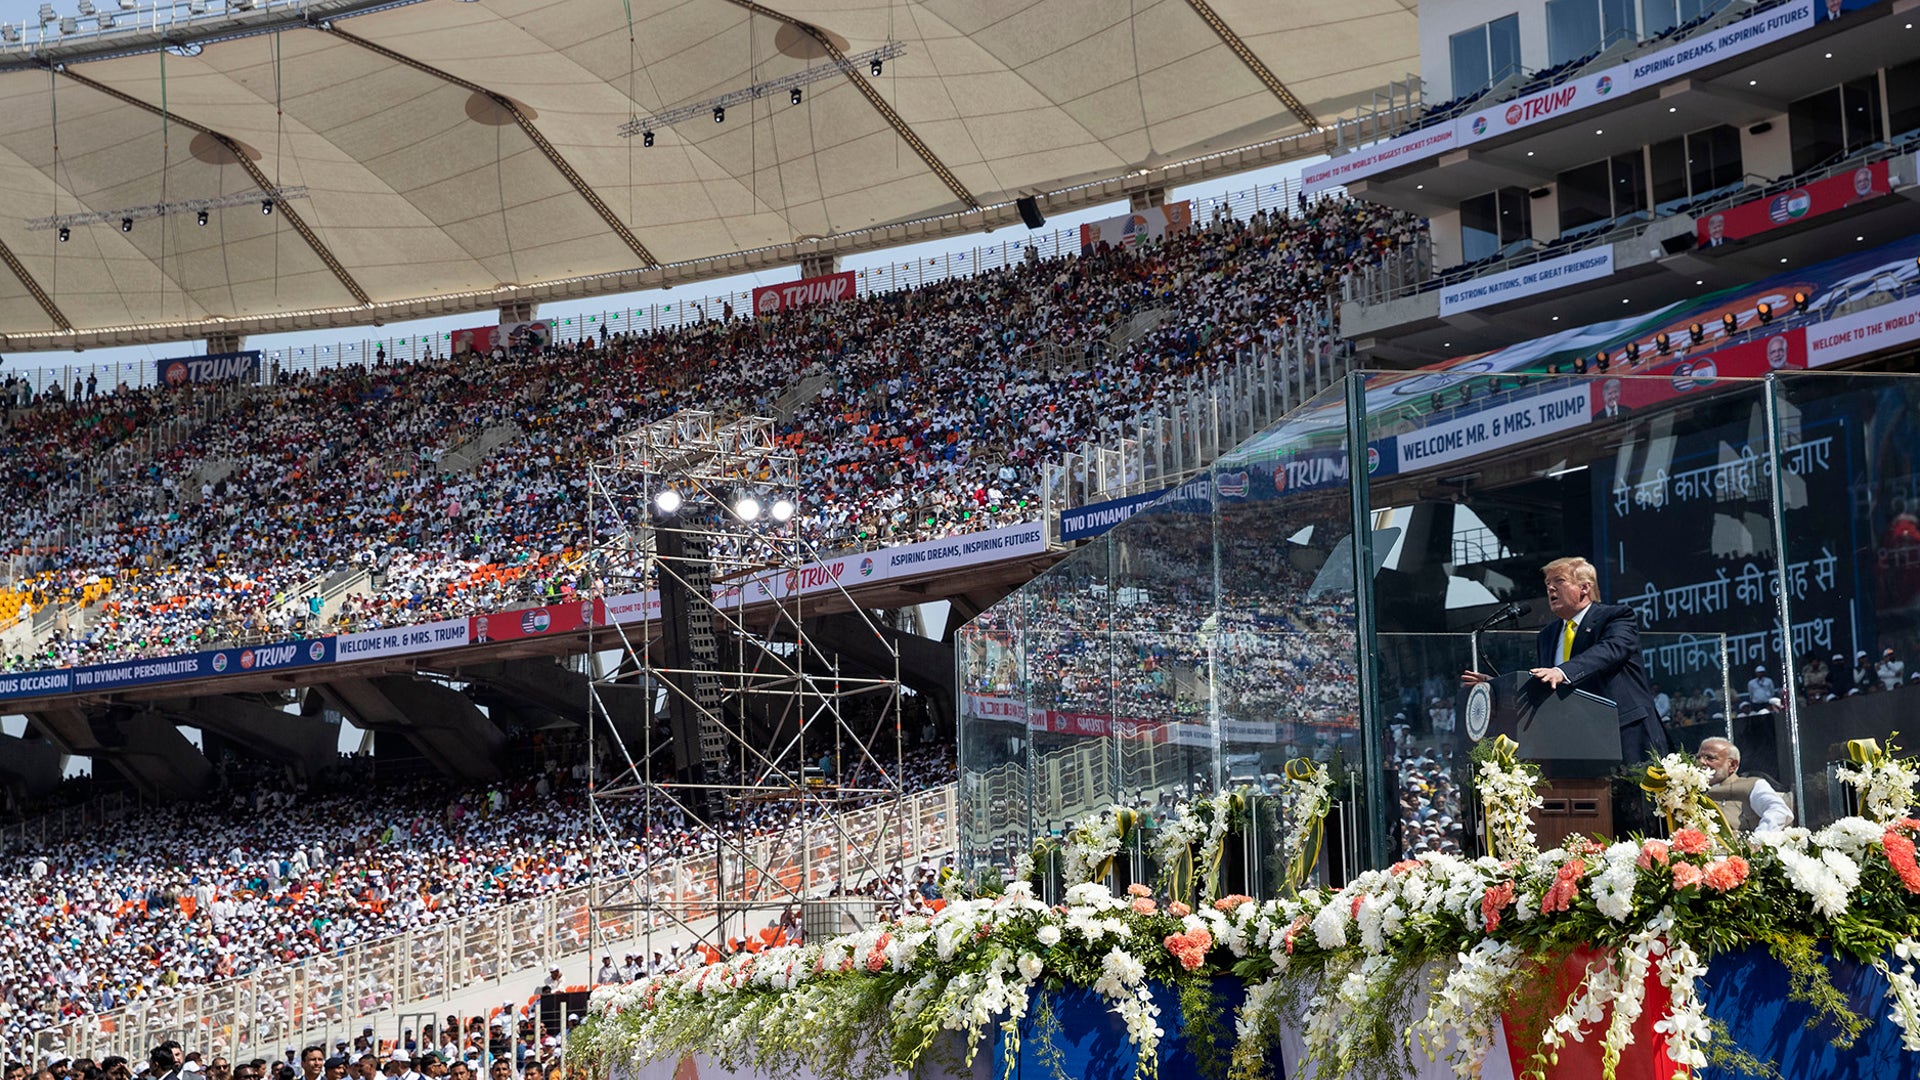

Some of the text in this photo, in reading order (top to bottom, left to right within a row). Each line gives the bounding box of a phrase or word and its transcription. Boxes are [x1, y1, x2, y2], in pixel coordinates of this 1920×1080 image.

[1633, 6, 1809, 79] ASPIRING DREAMS, INSPIRING FUTURES
[1523, 86, 1577, 120] TRUMP
[1305, 130, 1453, 185] WELCOME TO THE WORLD'S BIGGEST CRICKET STADIUM
[783, 278, 847, 308] TRUMP
[1445, 255, 1608, 305] TWO STRONG NATIONS, ONE GREAT FRIENDSHIP
[1812, 331, 1852, 351] WELCOME
[1853, 328, 1865, 340] TO
[1866, 323, 1883, 336] THE
[187, 356, 252, 382] TRUMP
[1403, 395, 1585, 461] WELCOME MR. & MRS. TRUMP
[1786, 436, 1833, 476] जाए
[1613, 478, 1631, 517] से
[1634, 468, 1671, 512] कड़ी
[1673, 445, 1759, 502] कारवाही
[1063, 515, 1085, 533] TWO
[890, 531, 1040, 567] ASPIRING DREAMS, INSPIRING FUTURES
[800, 562, 844, 589] TRUMP
[1664, 567, 1731, 619] प्रयासों
[1735, 563, 1772, 605] की
[1813, 546, 1837, 592] से
[254, 644, 297, 667] TRUMP
[340, 625, 465, 654] WELCOME MR. & MRS. TRUMP
[20, 674, 69, 691] OCCASION
[75, 659, 198, 686] TWO DYNAMIC PERSONALITIES
